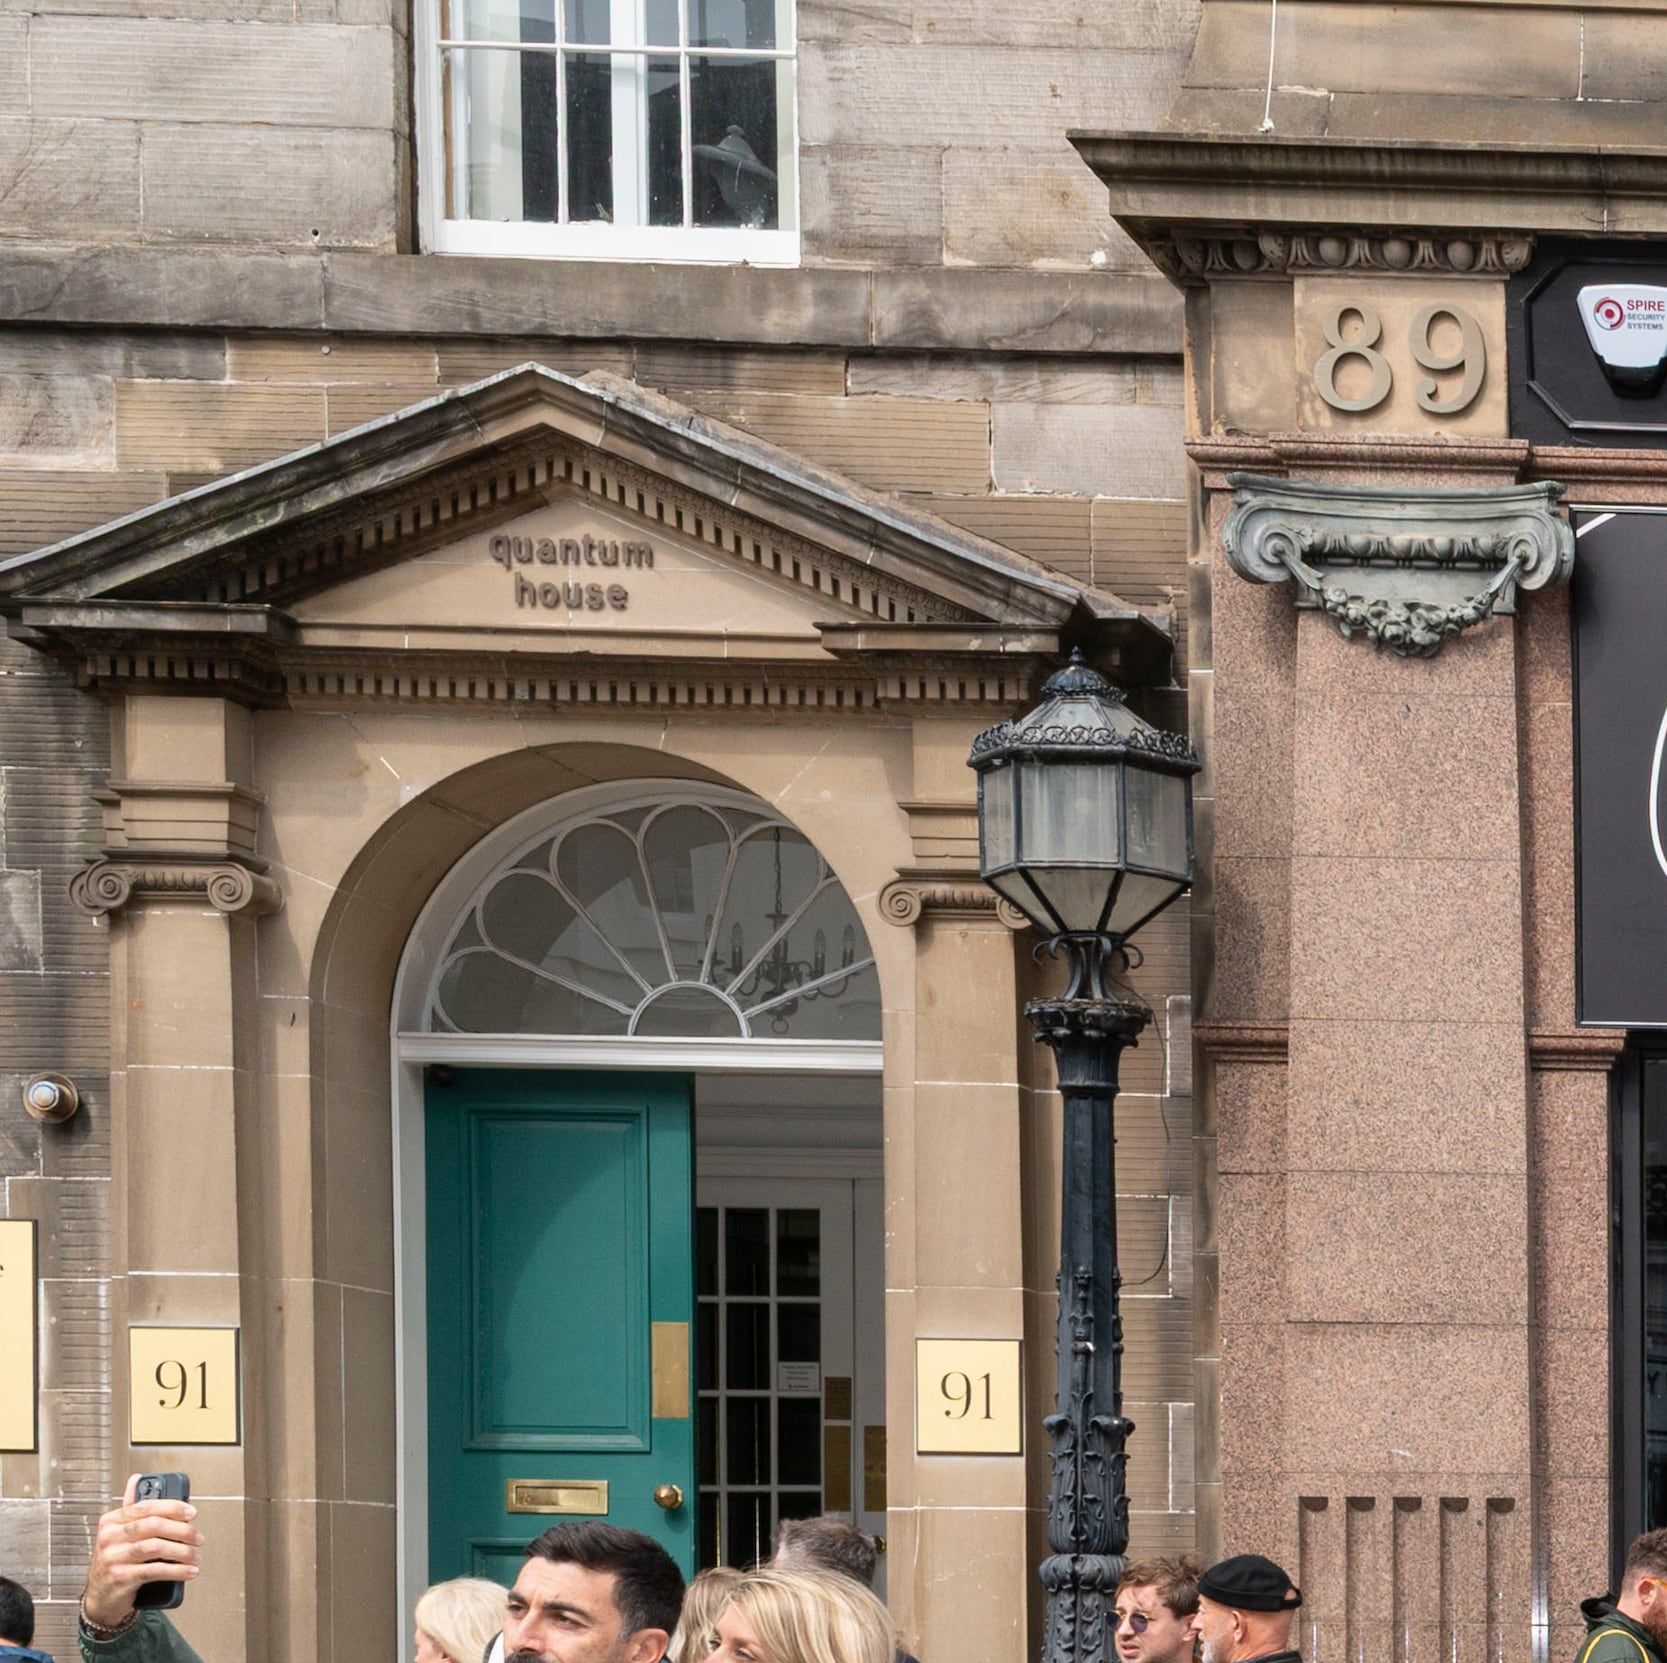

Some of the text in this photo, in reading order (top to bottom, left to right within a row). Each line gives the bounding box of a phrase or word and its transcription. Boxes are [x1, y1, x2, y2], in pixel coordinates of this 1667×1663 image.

[1627, 299, 1665, 311] SPIRE
[1627, 313, 1665, 321] SECURITY
[1627, 322, 1664, 330] SYSTEMS
[1313, 306, 1488, 414] 89
[489, 532, 654, 570] quantum
[514, 571, 629, 611] house
[154, 1360, 212, 1410] 91
[940, 1371, 995, 1421] 91
